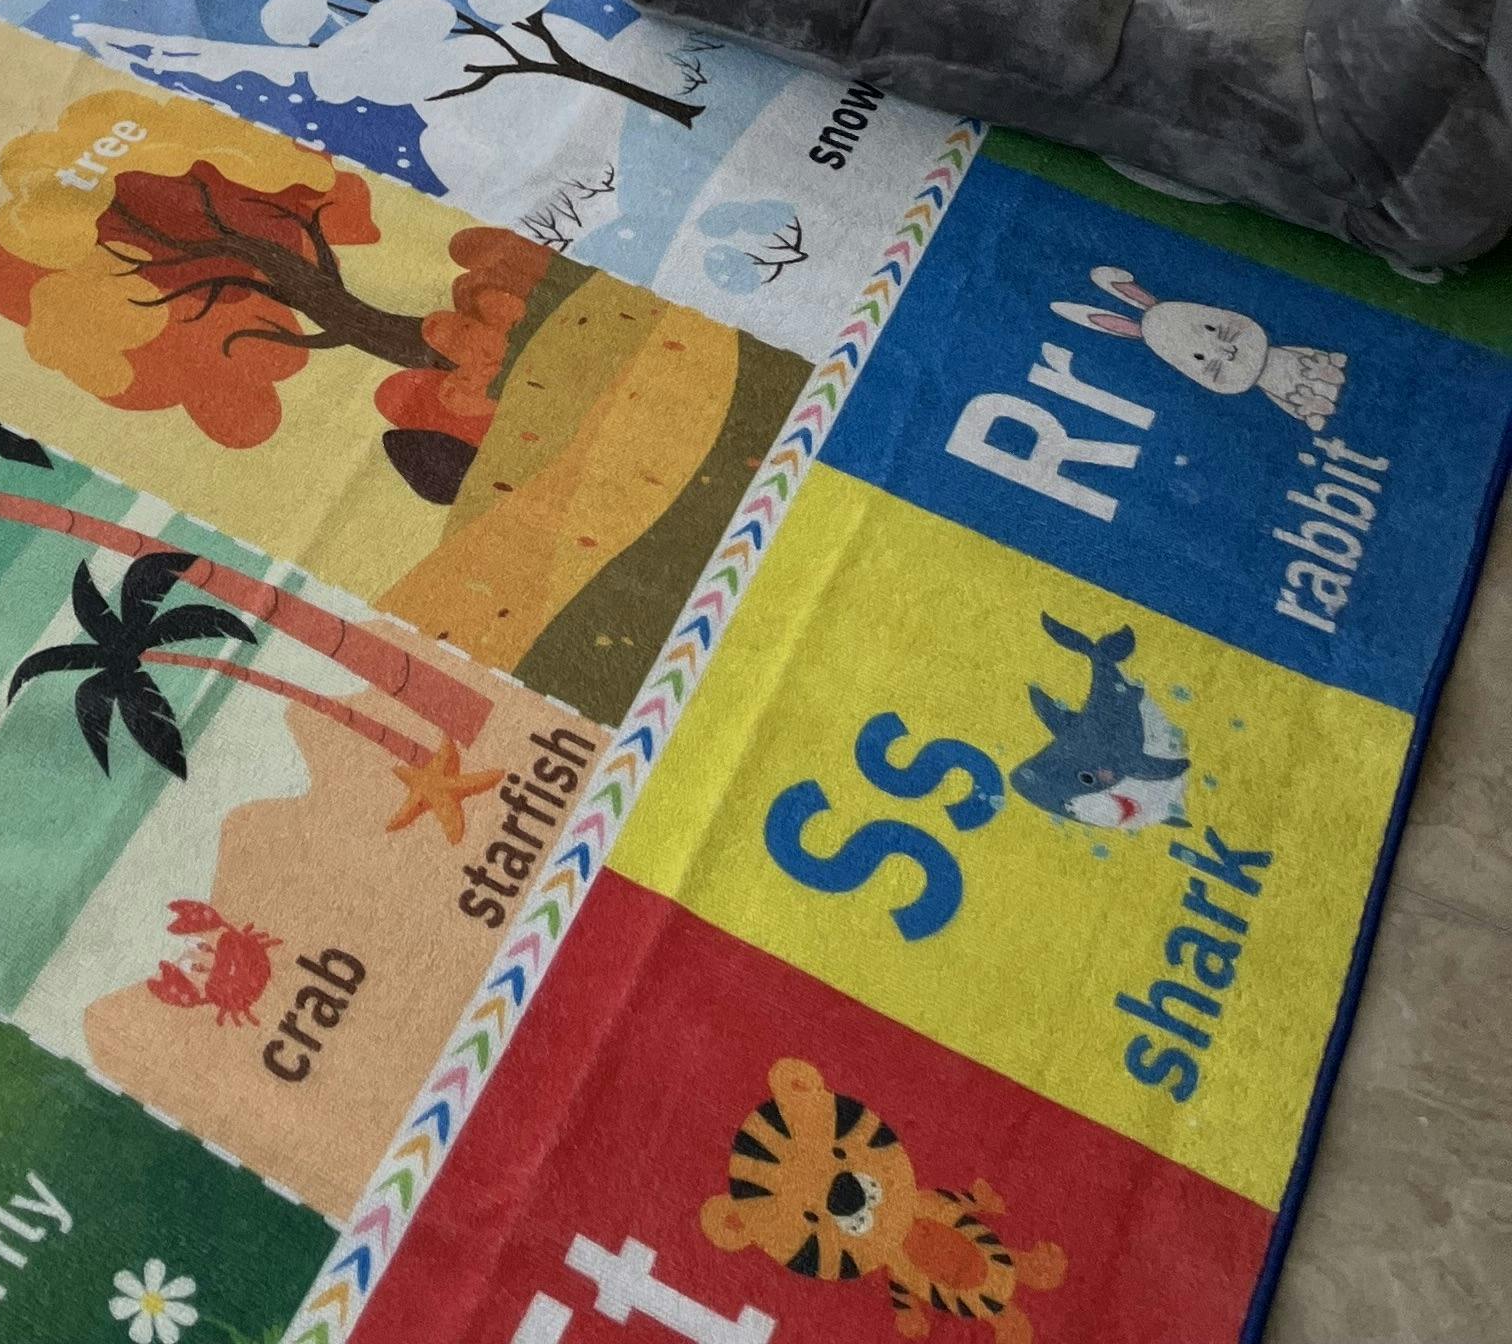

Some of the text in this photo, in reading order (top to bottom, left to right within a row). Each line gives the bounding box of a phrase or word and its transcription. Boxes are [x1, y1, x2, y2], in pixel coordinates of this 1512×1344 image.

[54, 118, 148, 192] tree
[809, 79, 885, 171] snow
[945, 341, 1156, 524] Rr
[1274, 435, 1390, 633] rabbit
[458, 725, 597, 929] starfish
[763, 711, 1005, 943] Ss
[263, 947, 366, 1083] crab
[1114, 825, 1274, 1105] shark
